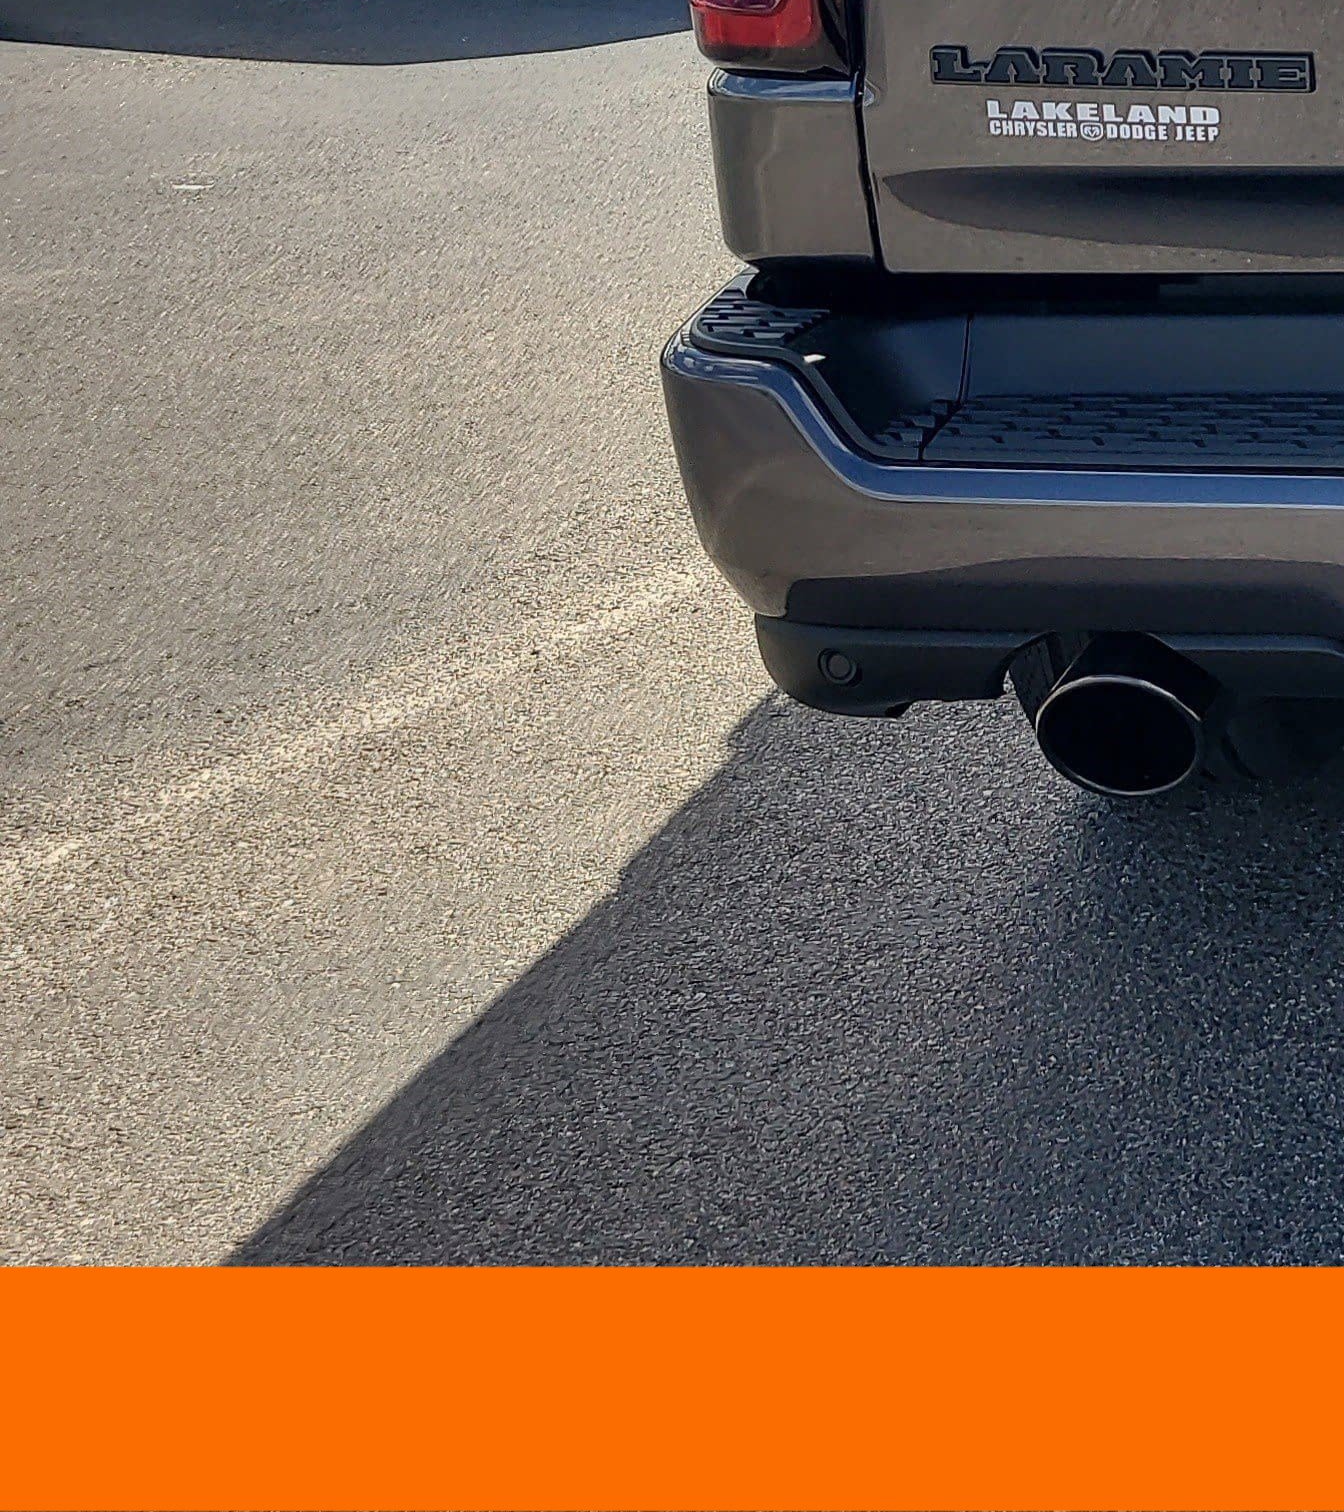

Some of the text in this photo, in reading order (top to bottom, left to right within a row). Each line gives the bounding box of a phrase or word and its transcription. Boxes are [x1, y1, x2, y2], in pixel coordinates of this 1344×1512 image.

[929, 44, 1317, 93] LARAMIE
[985, 99, 1221, 125] LAKELAND
[988, 120, 1219, 142] CHRYSLER DODGE JEEP
